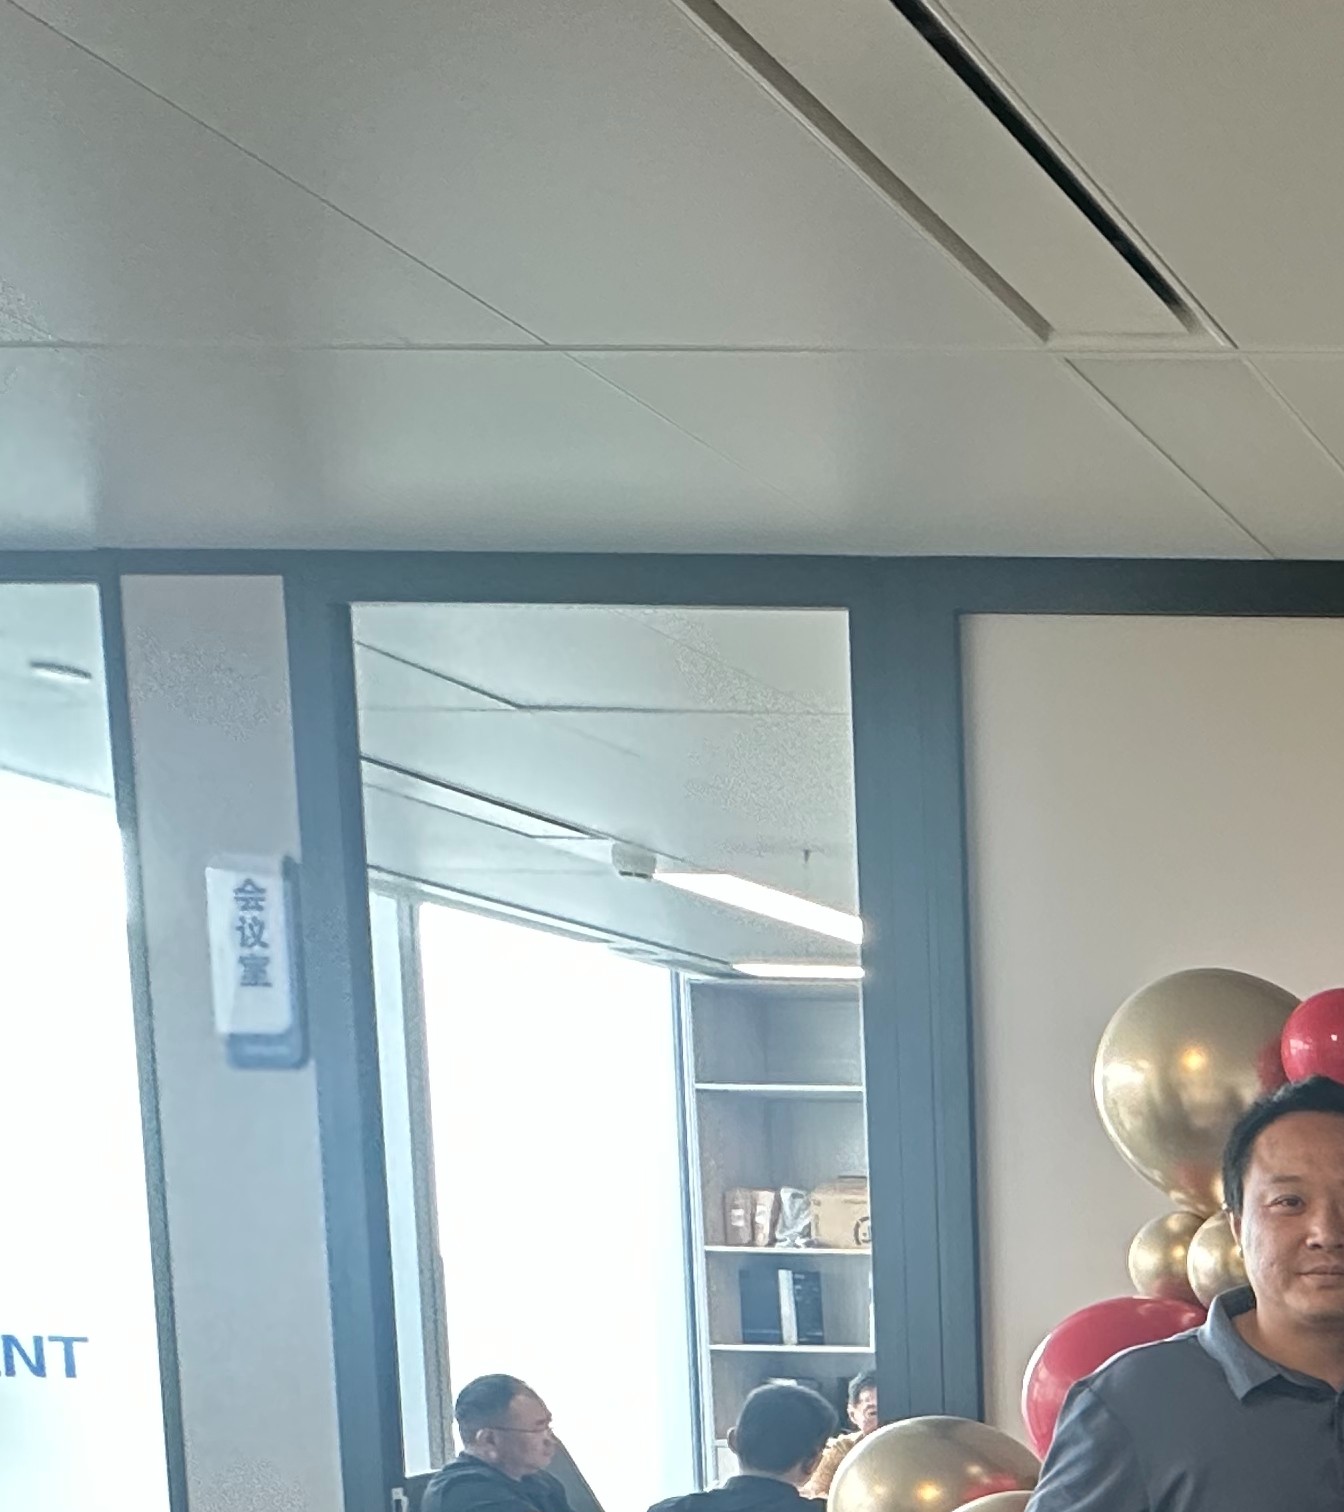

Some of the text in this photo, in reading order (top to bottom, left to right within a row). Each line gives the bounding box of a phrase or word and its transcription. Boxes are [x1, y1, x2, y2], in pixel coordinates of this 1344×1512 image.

[233, 878, 273, 987] 会议室
[0, 1334, 89, 1378] NT
